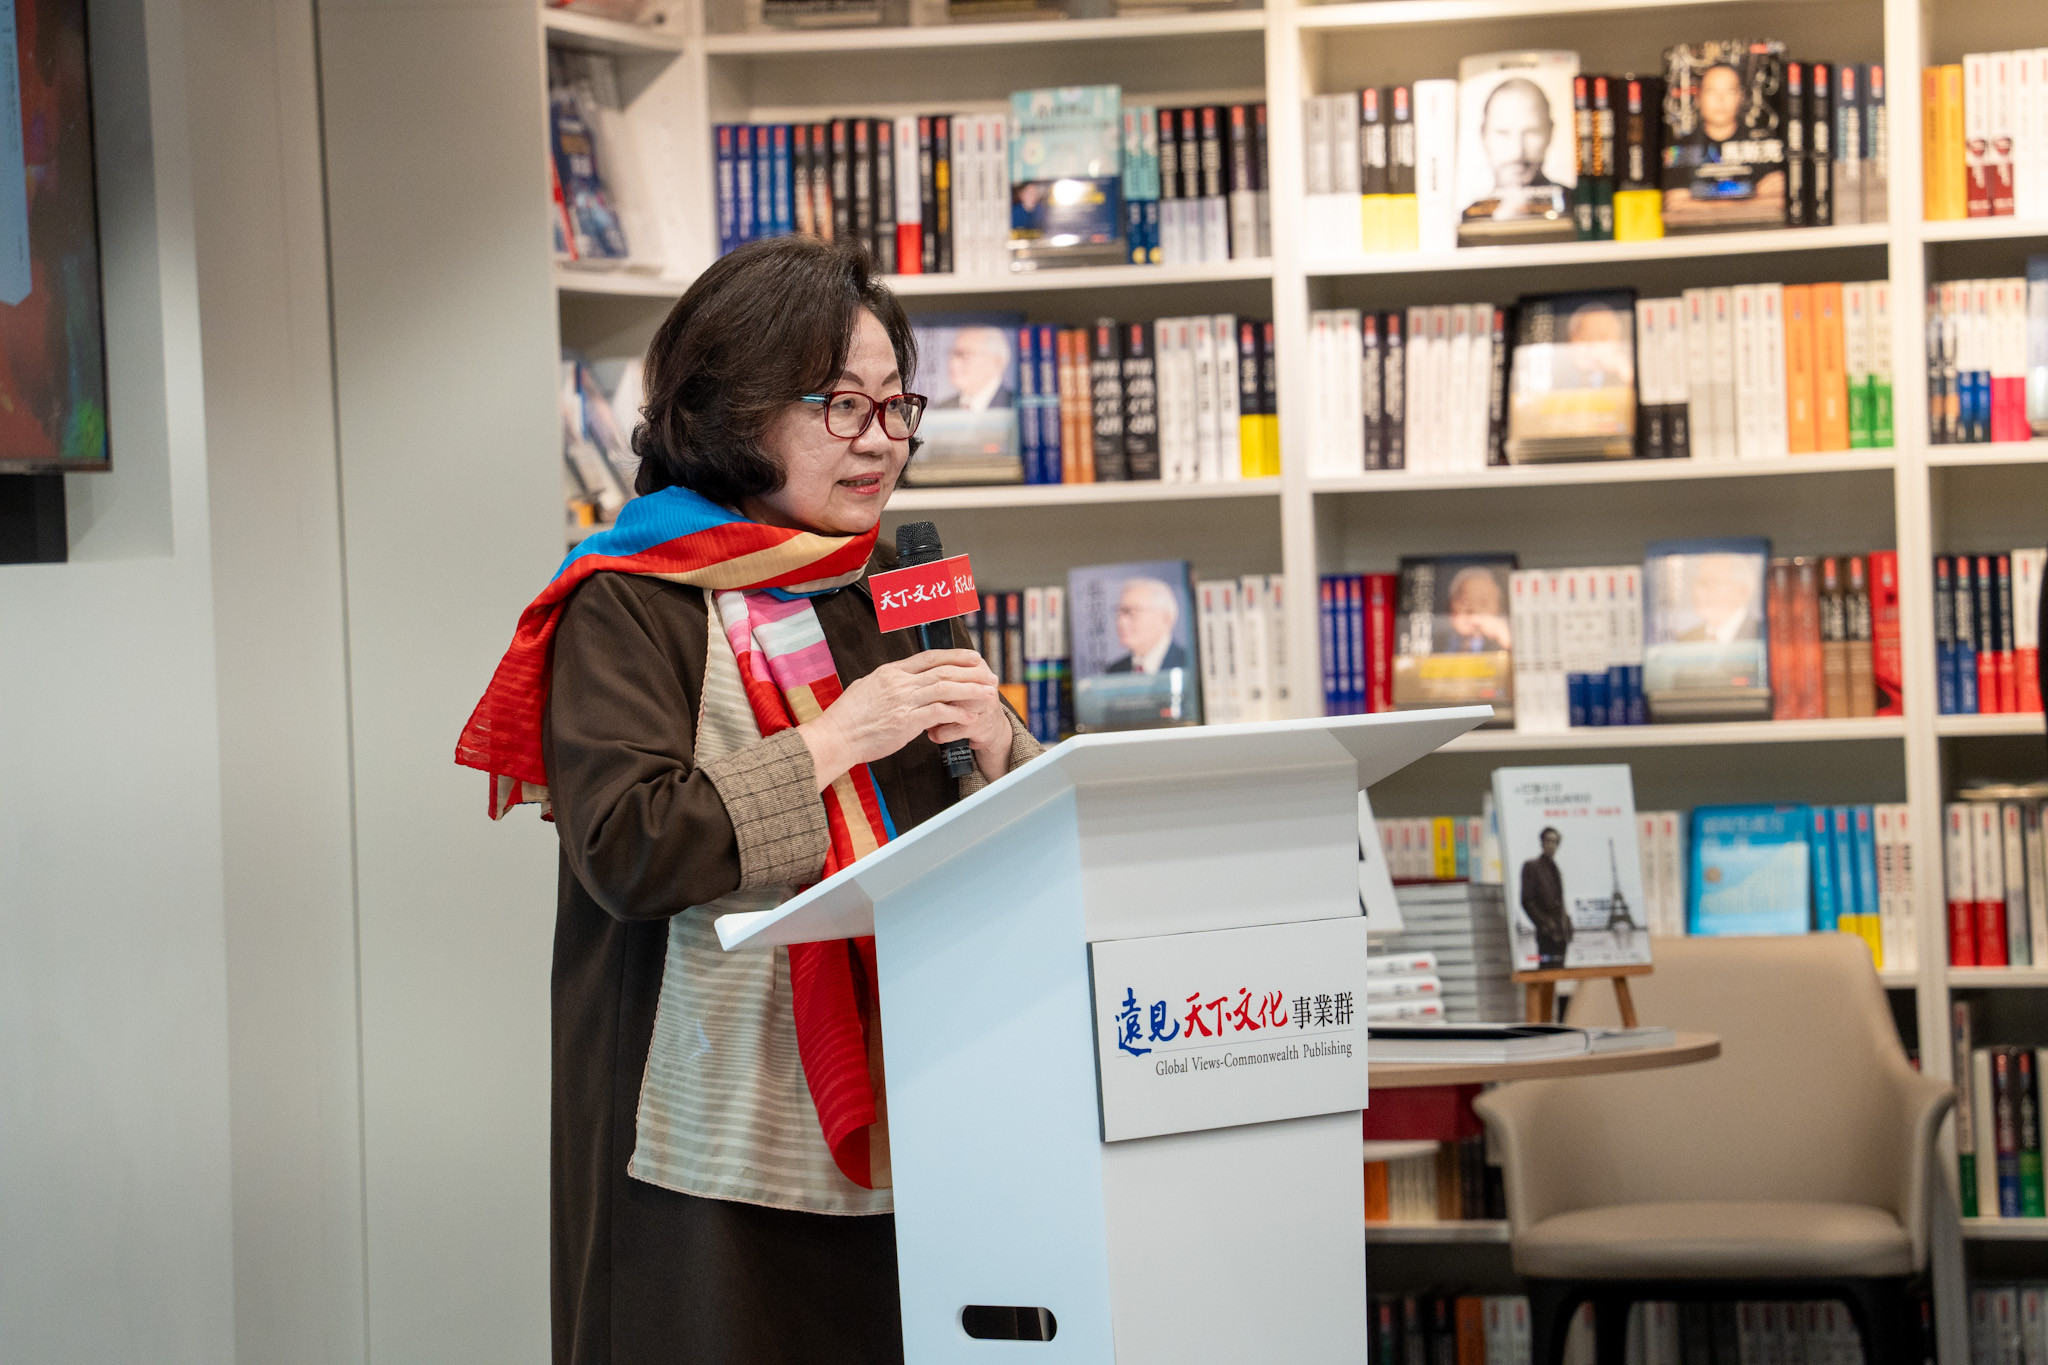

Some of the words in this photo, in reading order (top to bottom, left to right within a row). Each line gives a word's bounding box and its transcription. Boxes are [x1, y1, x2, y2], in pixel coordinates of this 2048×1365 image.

[880, 580, 951, 610] 天下文化
[1156, 1057, 1188, 1076] Global
[1191, 1045, 1299, 1072] Views-Commonwealth
[1303, 1041, 1352, 1059] Publishing
